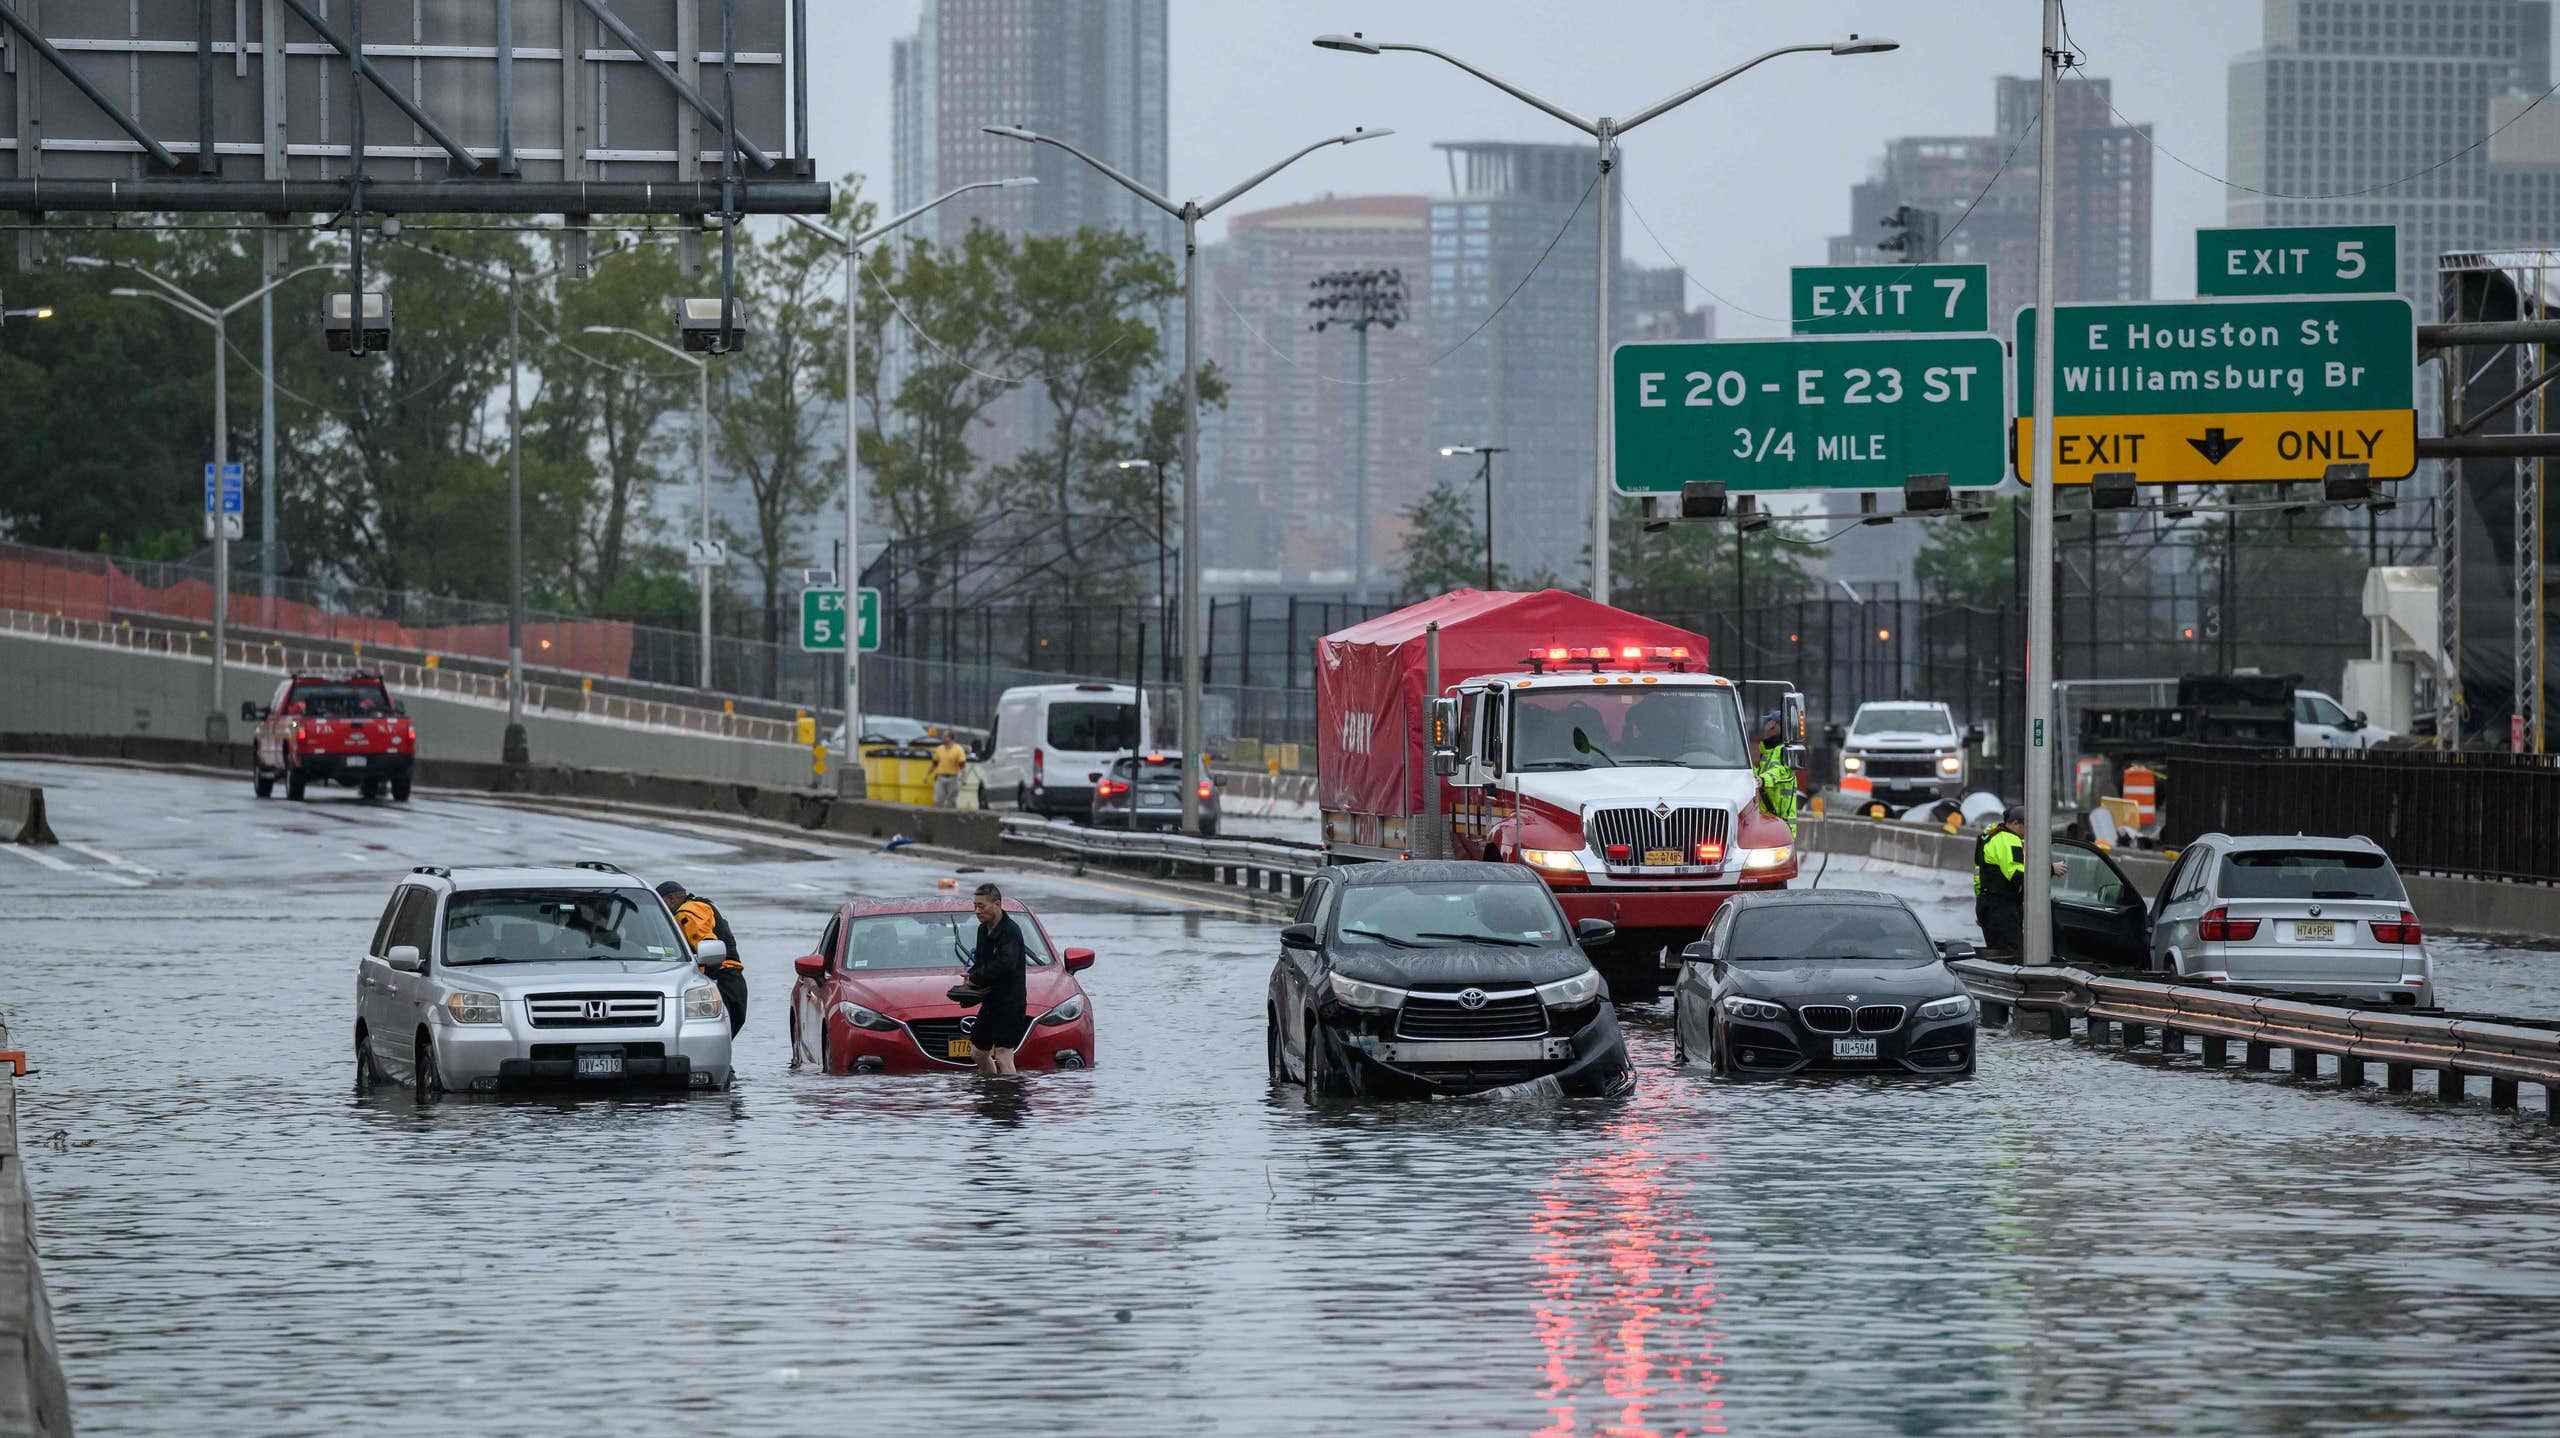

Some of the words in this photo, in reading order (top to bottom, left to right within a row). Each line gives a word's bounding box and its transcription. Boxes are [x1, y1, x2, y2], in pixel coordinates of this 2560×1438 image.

[2227, 248, 2309, 275] EXIT
[2335, 241, 2366, 279] 5
[1812, 284, 1912, 316] EXIT
[1933, 278, 1966, 318] 7
[2088, 324, 2109, 350] E
[2128, 322, 2279, 350] Houston
[2300, 319, 2339, 346] St
[1639, 372, 1666, 408] E
[1684, 370, 1746, 407] 20
[1797, 369, 1825, 405] E
[1843, 367, 1904, 404] 23
[1922, 366, 1977, 403] ST
[2063, 364, 2304, 397] Williamsburg
[2324, 361, 2365, 387] Br
[1732, 427, 1796, 462] 3/4
[1817, 434, 1887, 461] MILE
[2058, 434, 2145, 465] EXIT
[2276, 429, 2384, 460] ONLY
[818, 595, 868, 611] EXT
[813, 619, 831, 642] 5
[1342, 710, 1373, 754] FDNY
